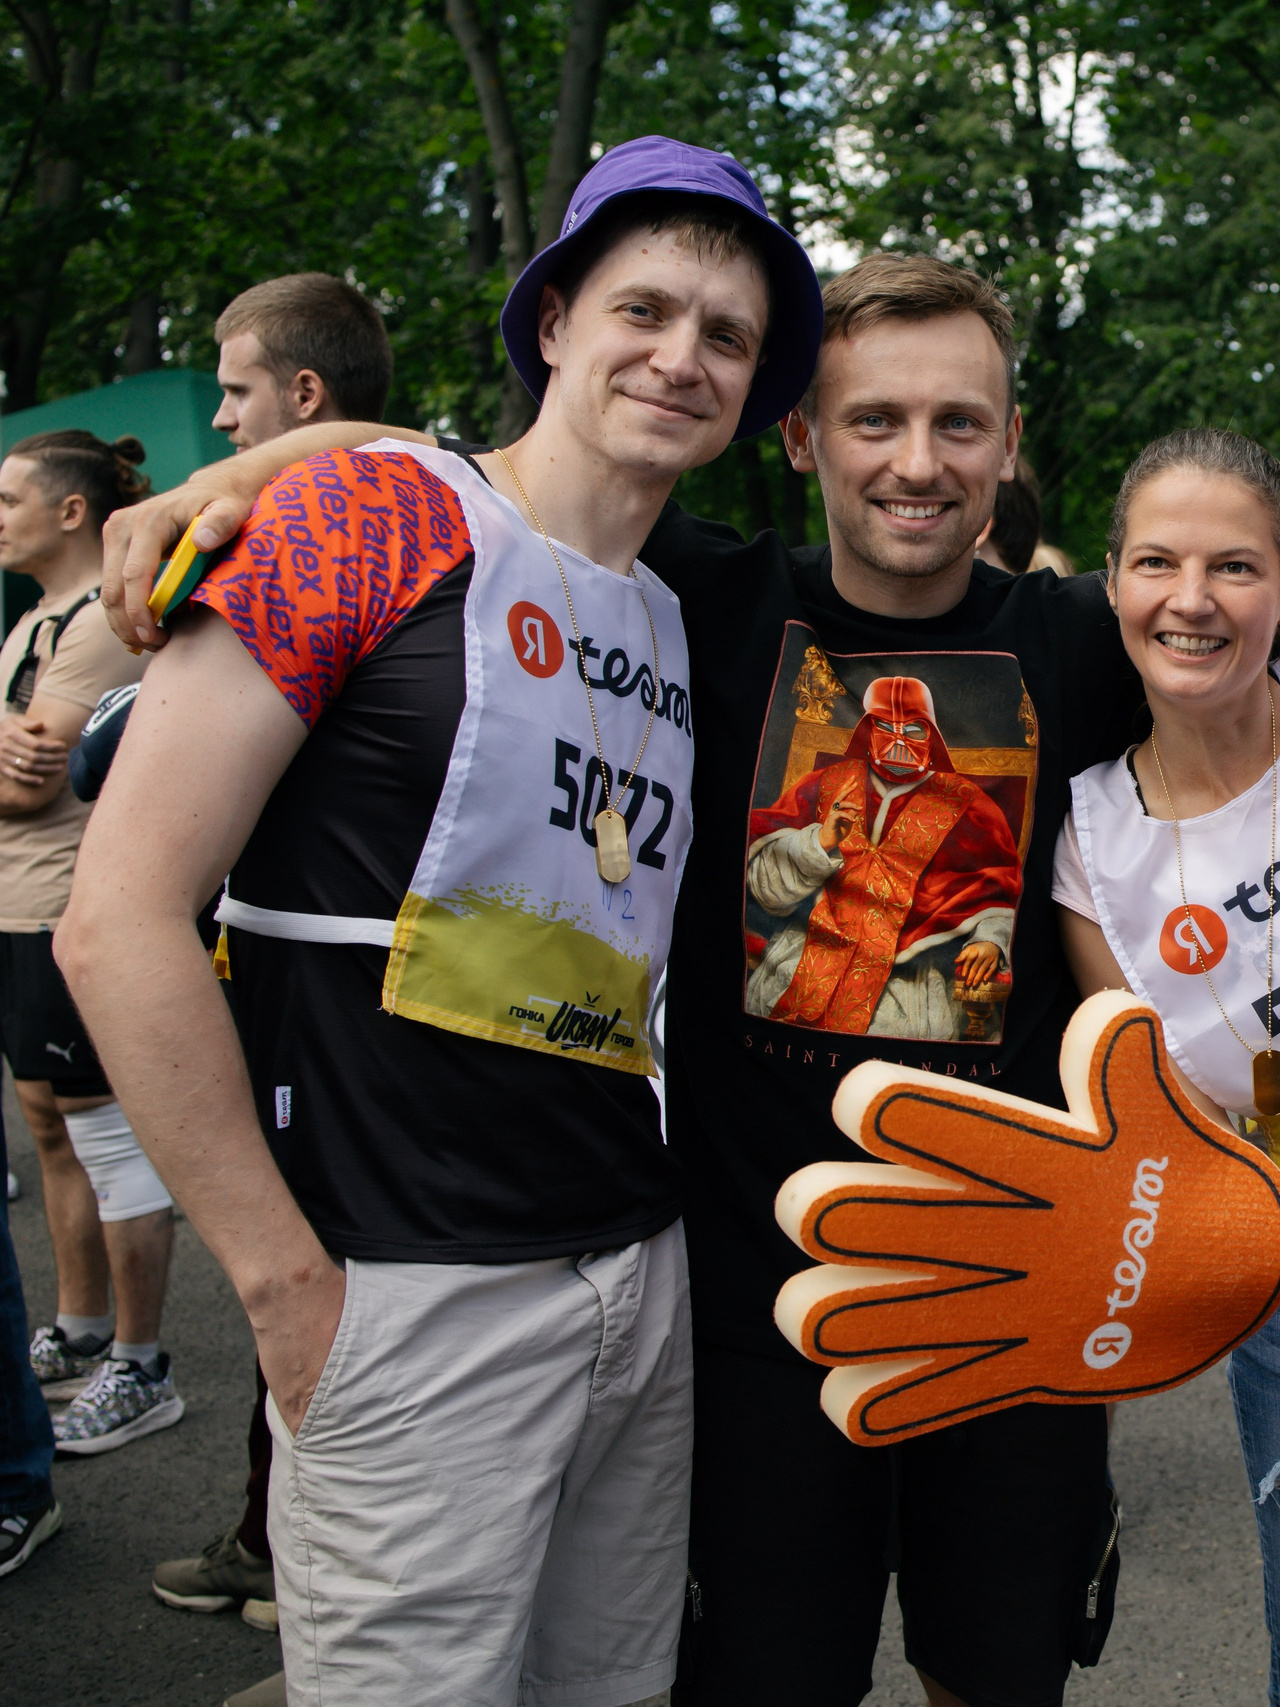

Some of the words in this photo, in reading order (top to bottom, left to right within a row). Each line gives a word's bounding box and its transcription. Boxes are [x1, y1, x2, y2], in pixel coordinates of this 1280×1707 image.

[568, 636, 692, 738] team
[549, 737, 675, 871] 5072
[508, 1005, 546, 1034] ГОНКА
[545, 1001, 622, 1052] URBAN
[743, 1034, 840, 1068] SAINT
[1106, 1156, 1170, 1318] team
